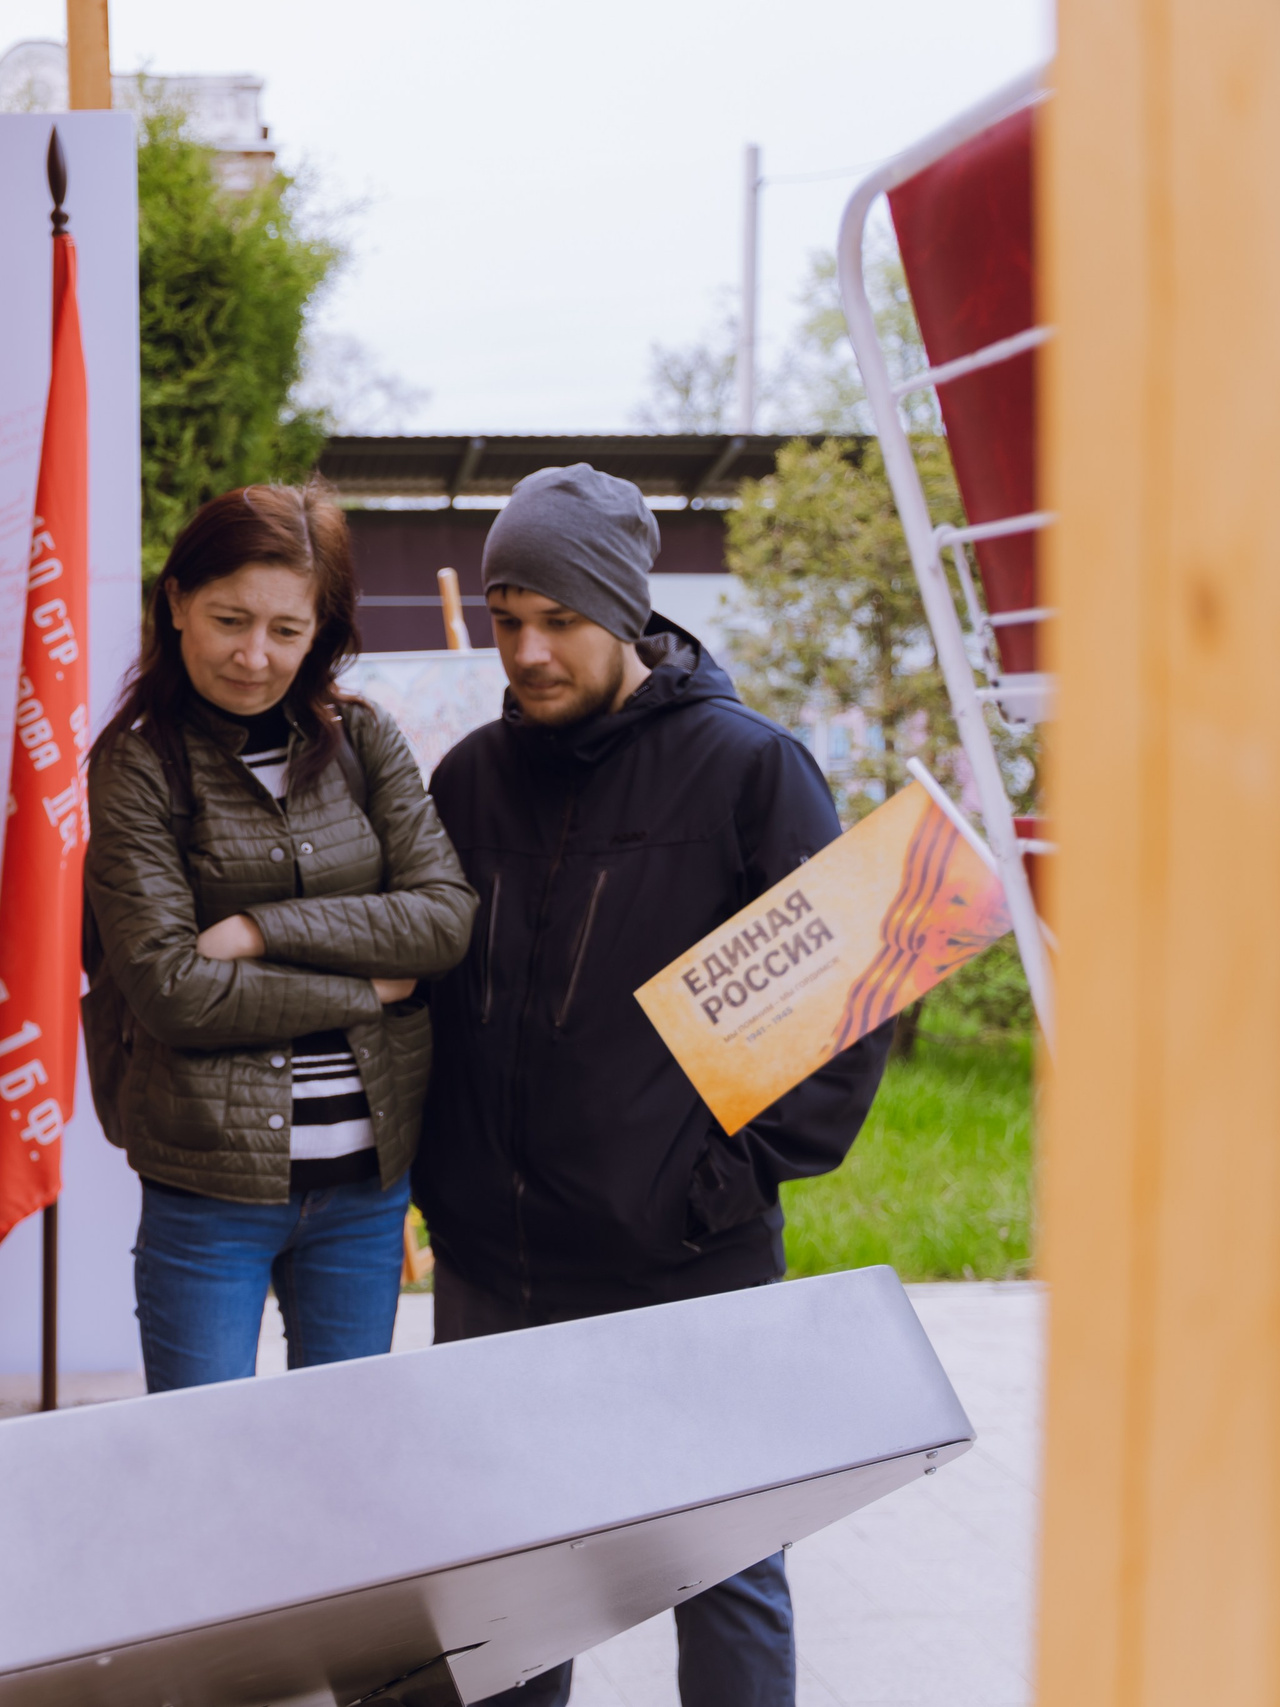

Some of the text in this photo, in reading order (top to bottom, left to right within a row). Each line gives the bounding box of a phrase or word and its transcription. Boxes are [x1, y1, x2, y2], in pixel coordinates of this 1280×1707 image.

[32, 597, 80, 681] СТР.
[681, 889, 814, 997] ЕДИНАЯ
[699, 916, 835, 1026] РОССИЯ
[738, 1004, 774, 1033] ПОМНИМ
[746, 1026, 766, 1043] 1941
[772, 1006, 794, 1025] 1945
